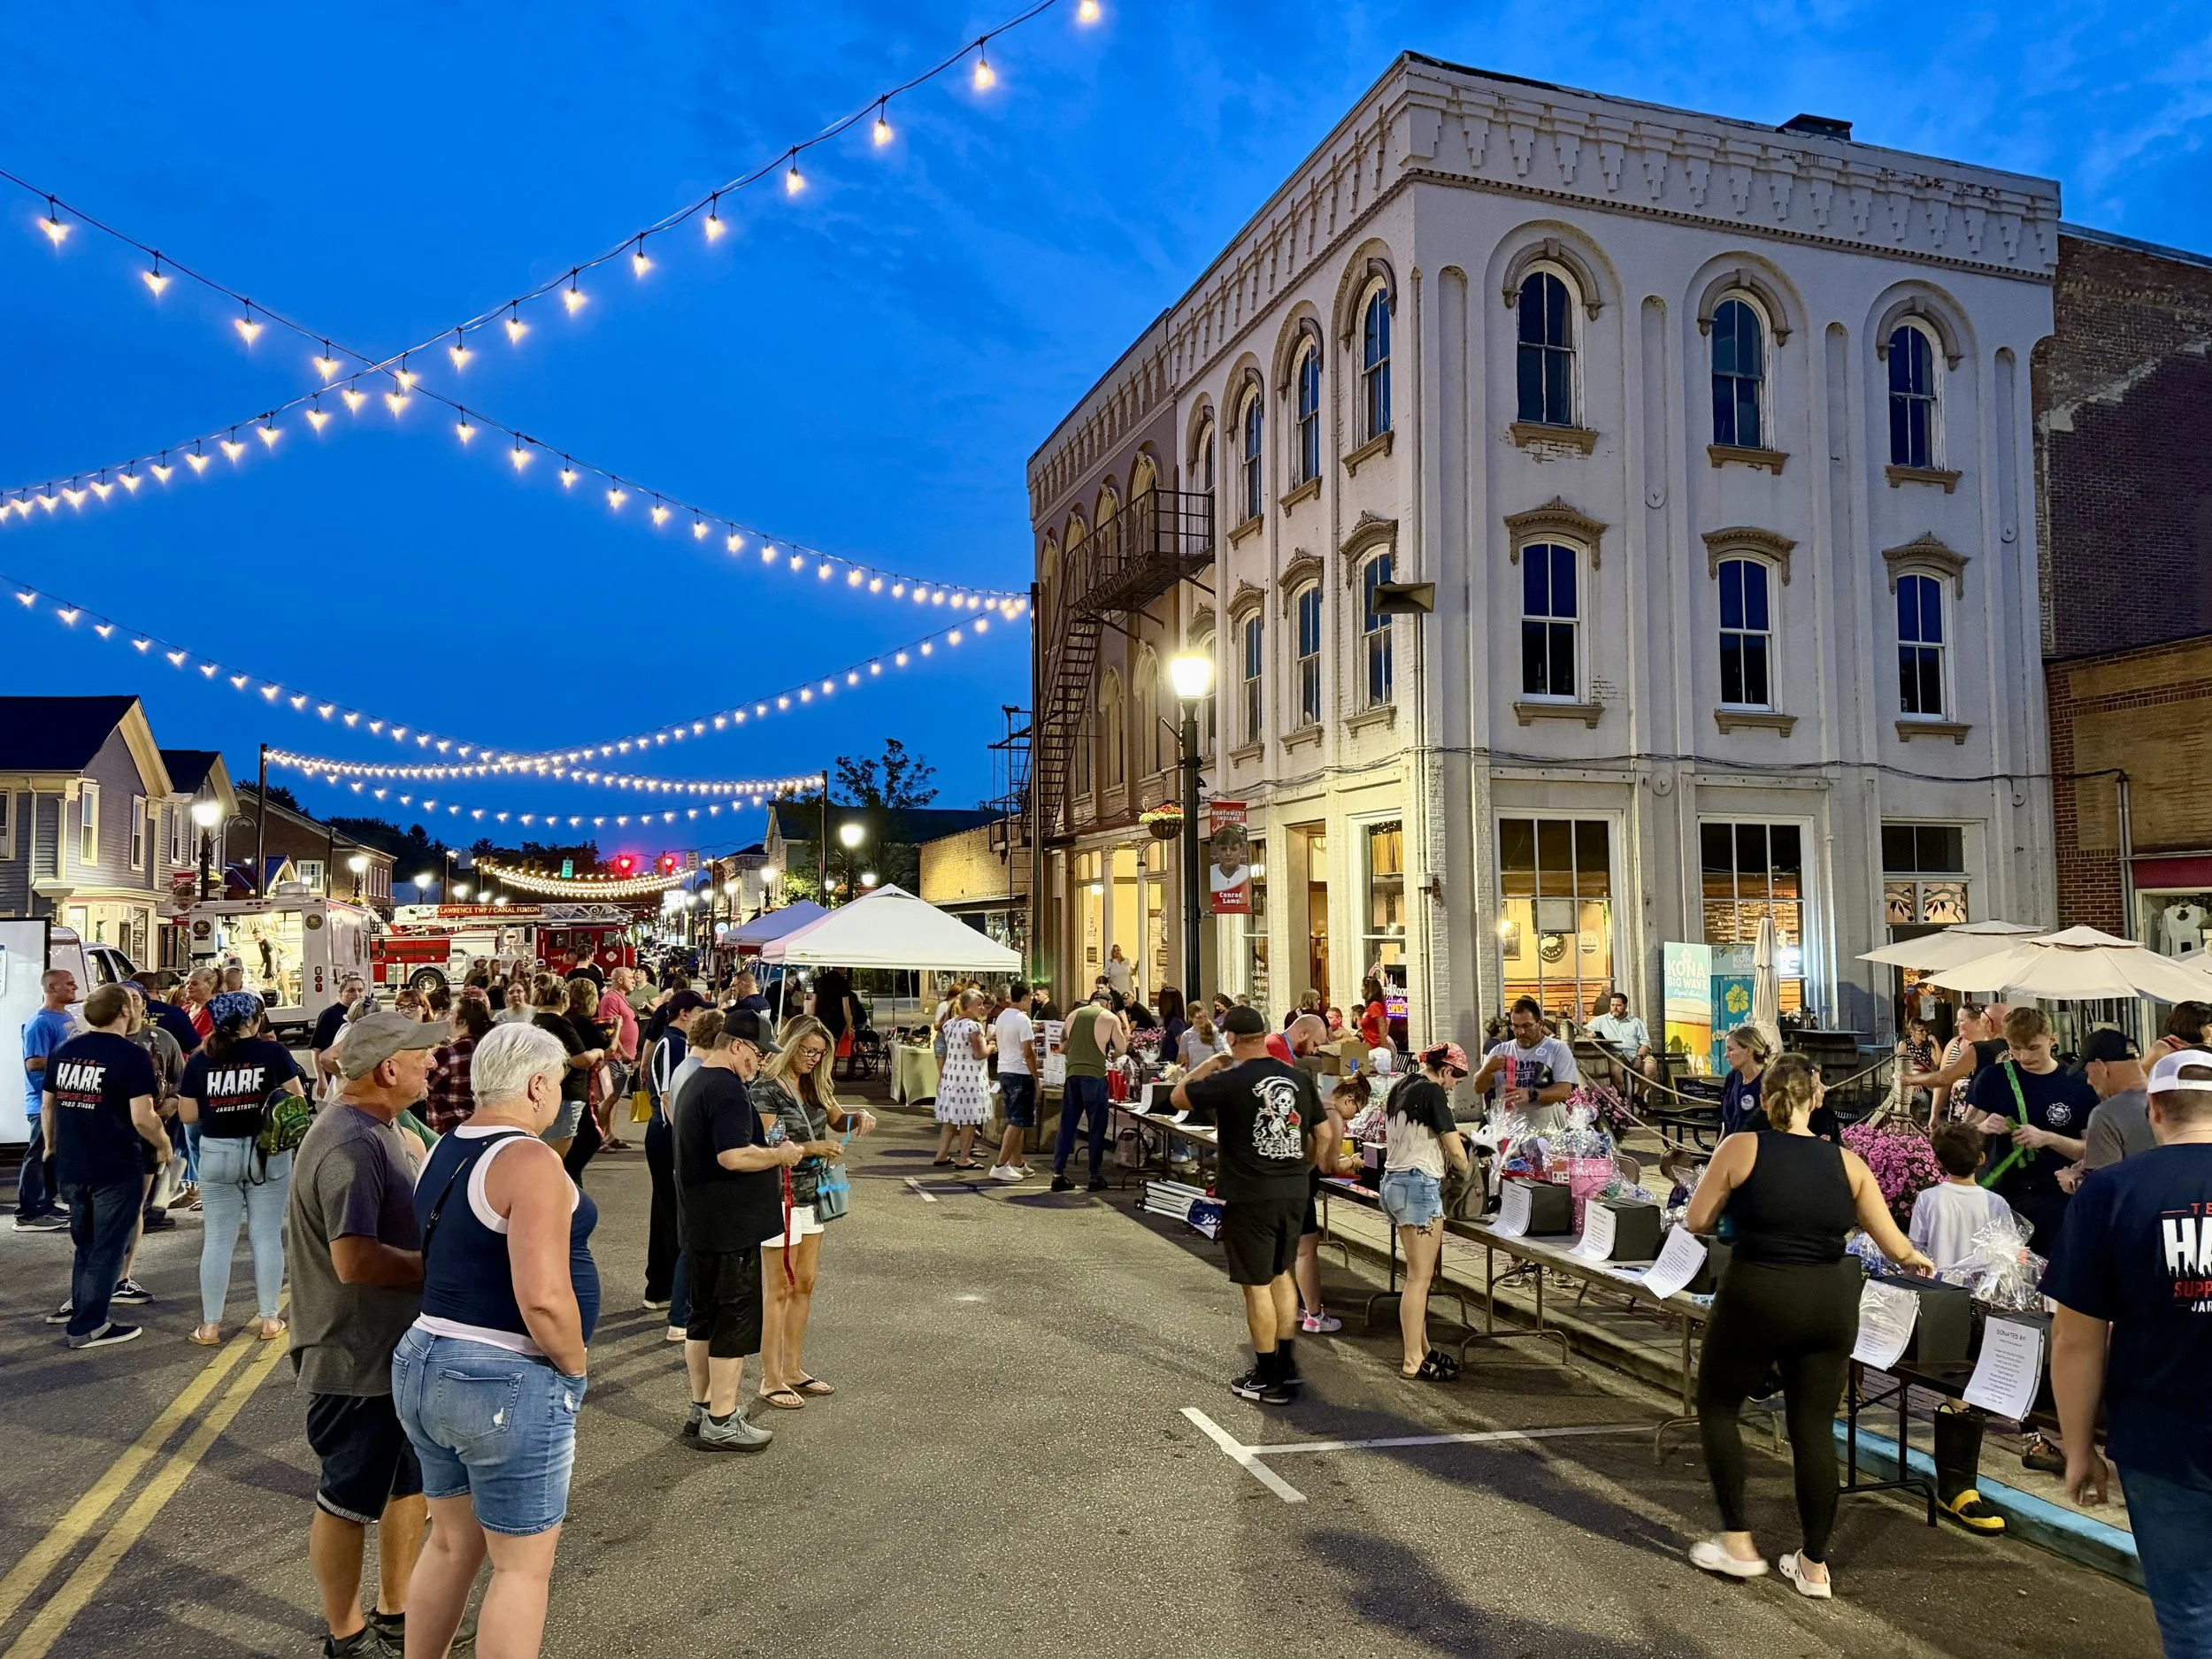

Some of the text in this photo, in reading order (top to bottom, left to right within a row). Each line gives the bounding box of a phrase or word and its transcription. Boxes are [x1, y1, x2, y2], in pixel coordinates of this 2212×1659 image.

[1666, 959, 1706, 979] KONA
[1667, 976, 1709, 991] BIG WAVE
[57, 1062, 106, 1094] HARE
[2190, 1203, 2212, 1216] TE
[2162, 1217, 2212, 1278] HA
[2174, 1280, 2212, 1299] SUPP
[2191, 1300, 2212, 1313] JAR
[1996, 1329, 2019, 1340] DONATED
